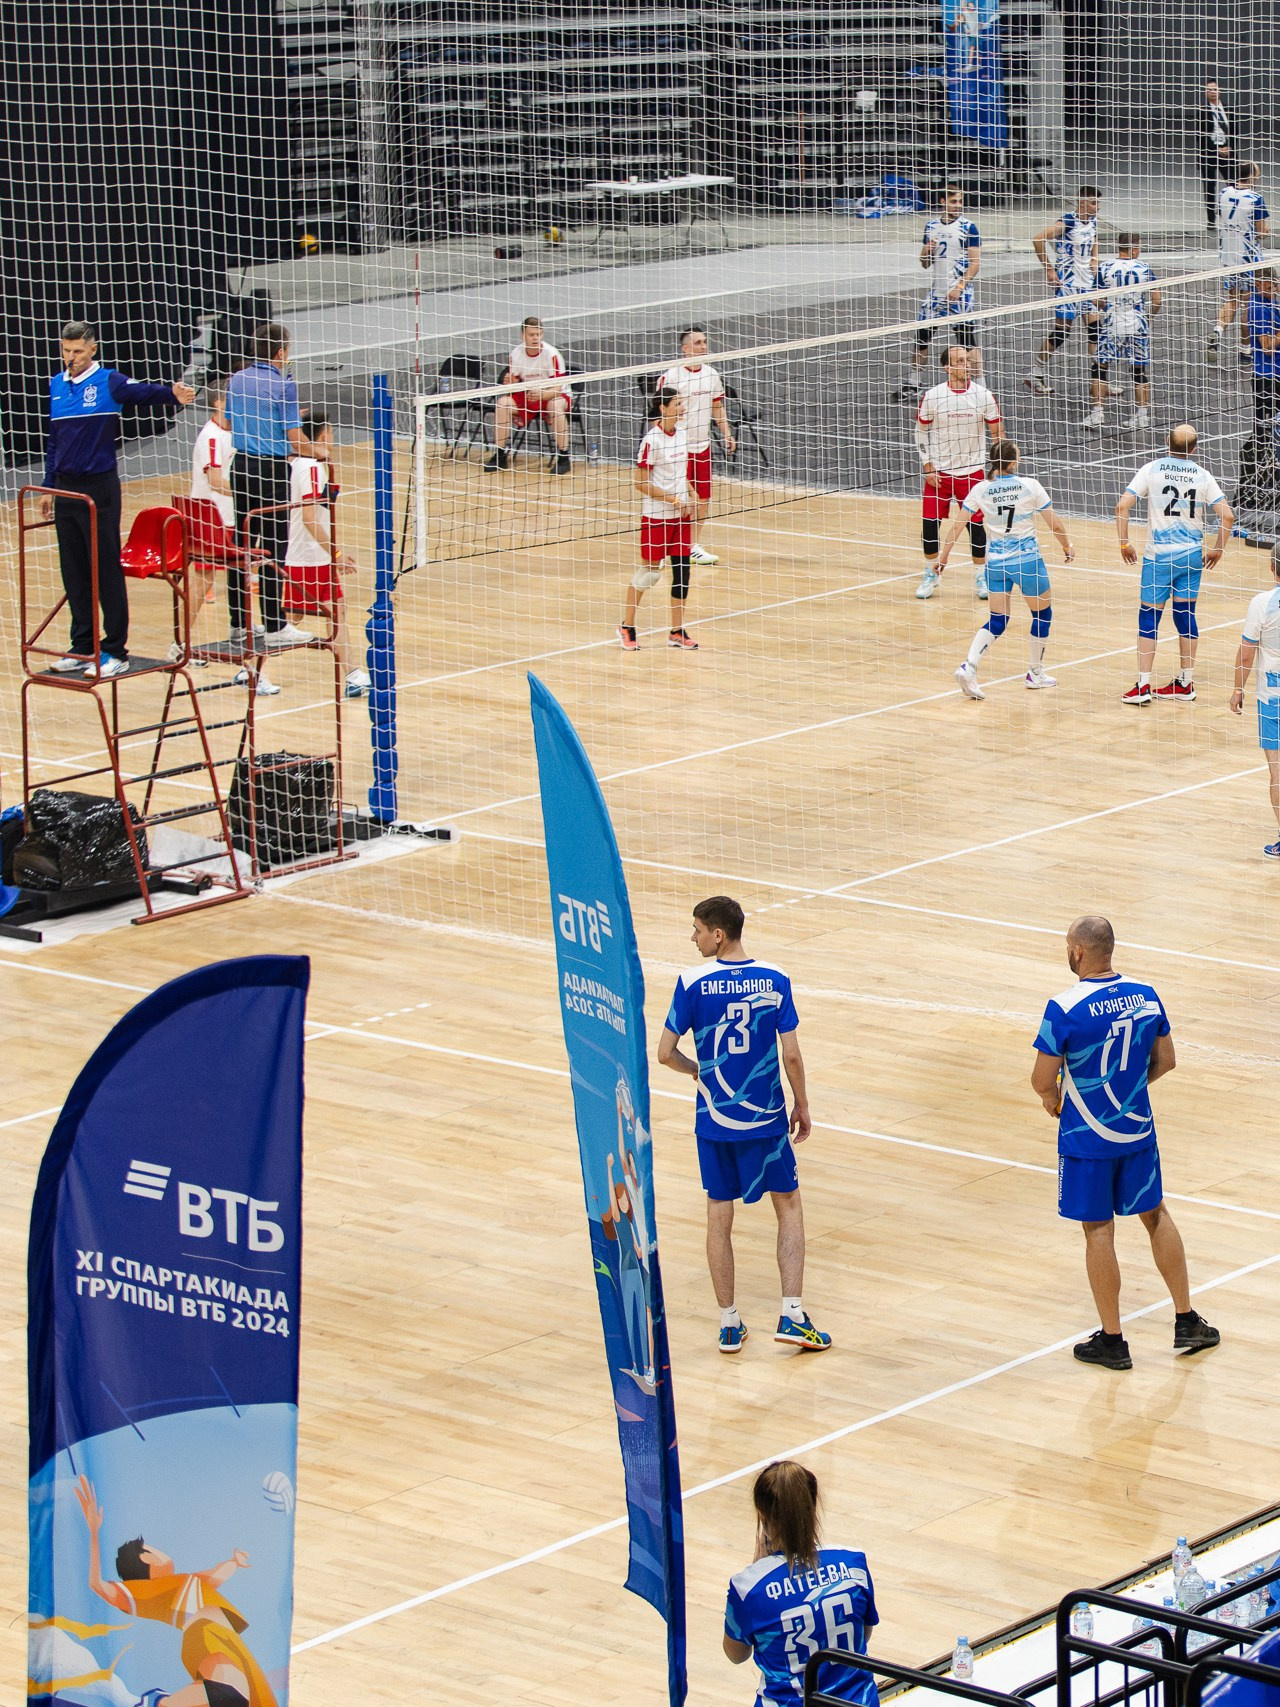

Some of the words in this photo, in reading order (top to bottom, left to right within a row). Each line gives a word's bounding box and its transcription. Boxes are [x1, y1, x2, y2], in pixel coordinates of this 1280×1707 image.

[1228, 197, 1240, 220] 7
[938, 241, 947, 258] 2
[1160, 463, 1198, 475] ДАЛЬНИЙ
[1164, 473, 1194, 483] ВОСТОК
[992, 494, 1019, 503] ВОСТОК
[1161, 485, 1197, 519] 21
[997, 504, 1016, 533] 7
[701, 978, 774, 996] ЕМЕЛЬЯНОВ
[1088, 993, 1147, 1017] КУЗНЕЦОВ
[727, 1001, 751, 1055] 3
[1111, 1018, 1133, 1072] 7
[178, 1181, 285, 1253] ВТБ
[76, 1250, 104, 1271] XI
[111, 1256, 290, 1313] СПАРТАКИАДА
[76, 1275, 175, 1314] ГРУППЫ
[181, 1297, 226, 1323] ВТБ
[231, 1308, 290, 1338] 2024
[765, 1561, 852, 1600] ФАТЕЕВА
[780, 1592, 855, 1674] 36
